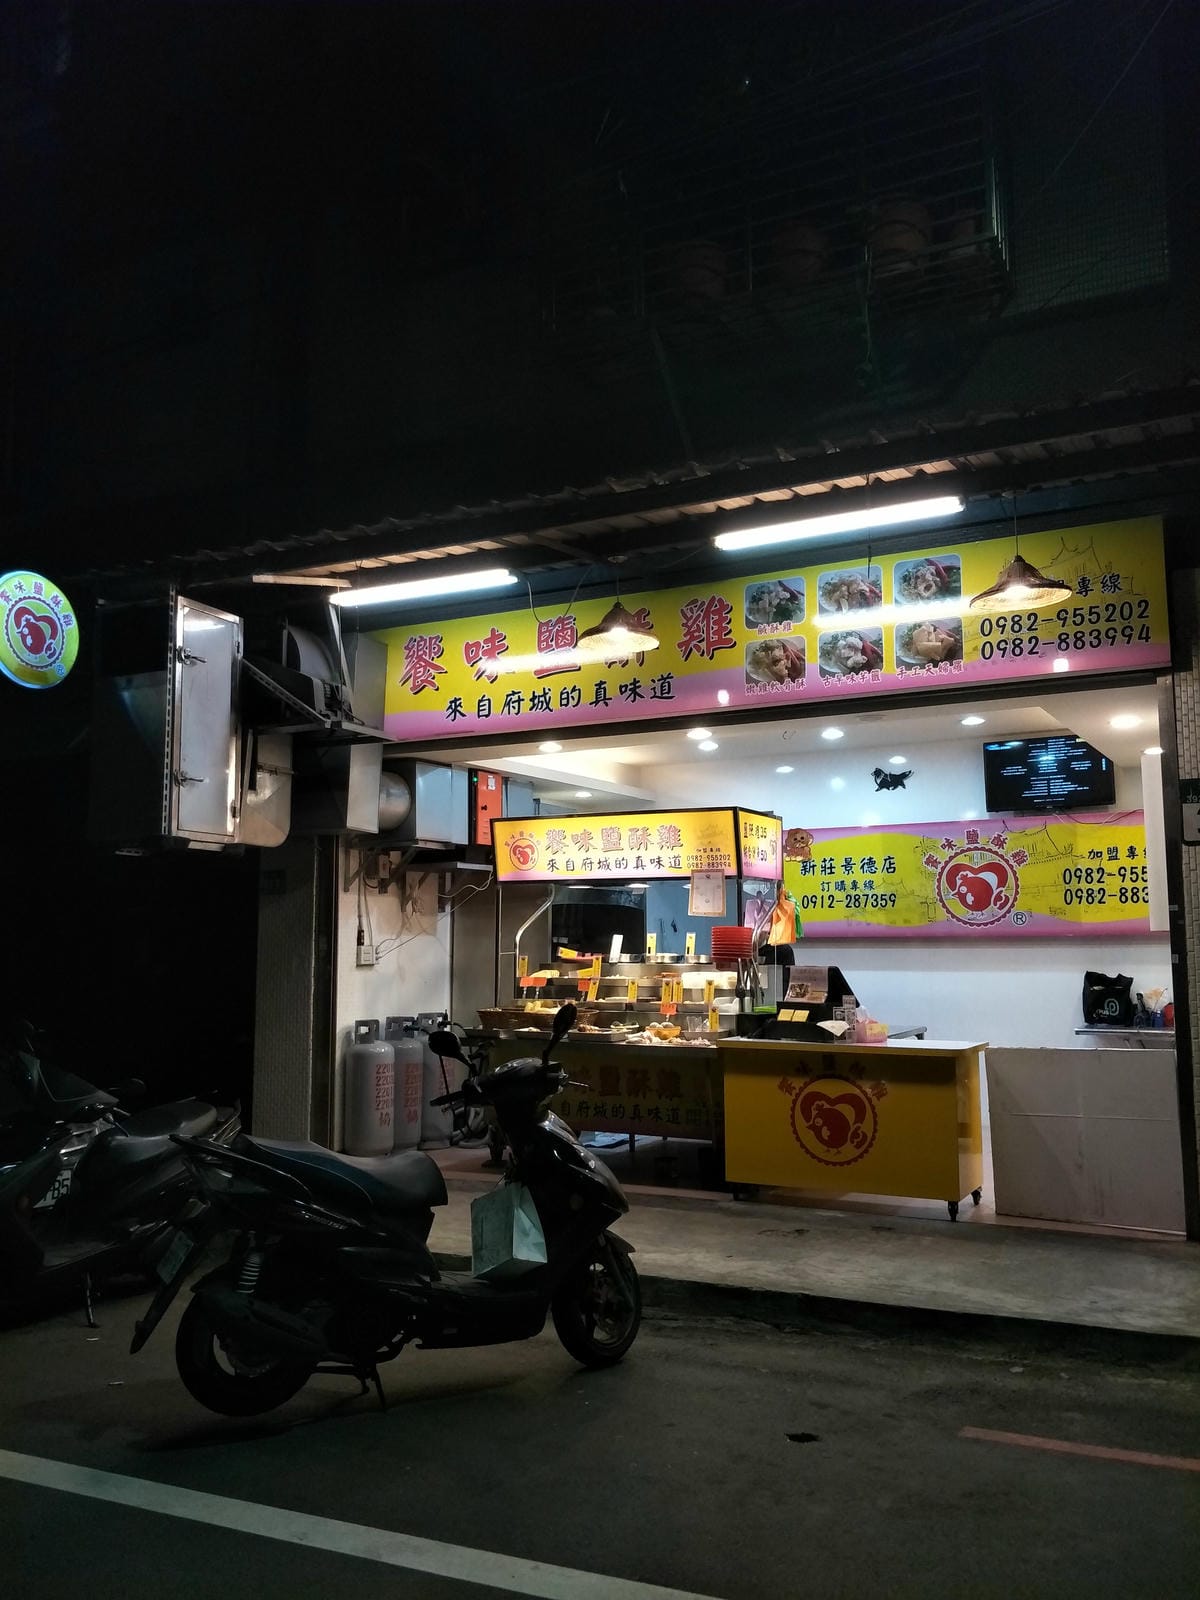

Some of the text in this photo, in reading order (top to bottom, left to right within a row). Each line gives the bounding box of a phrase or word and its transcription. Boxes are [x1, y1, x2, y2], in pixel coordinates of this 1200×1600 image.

[980, 599, 1150, 637] 0982-955202
[980, 624, 1152, 660] 0982-883994
[445, 673, 675, 722] 來自府城的真味道
[1087, 845, 1147, 861] 加盟專
[546, 854, 683, 873] 來自府城的真味道
[800, 856, 897, 876] 新莊景德店
[820, 880, 876, 892] 訂購專線
[801, 893, 897, 909] 0912-287359
